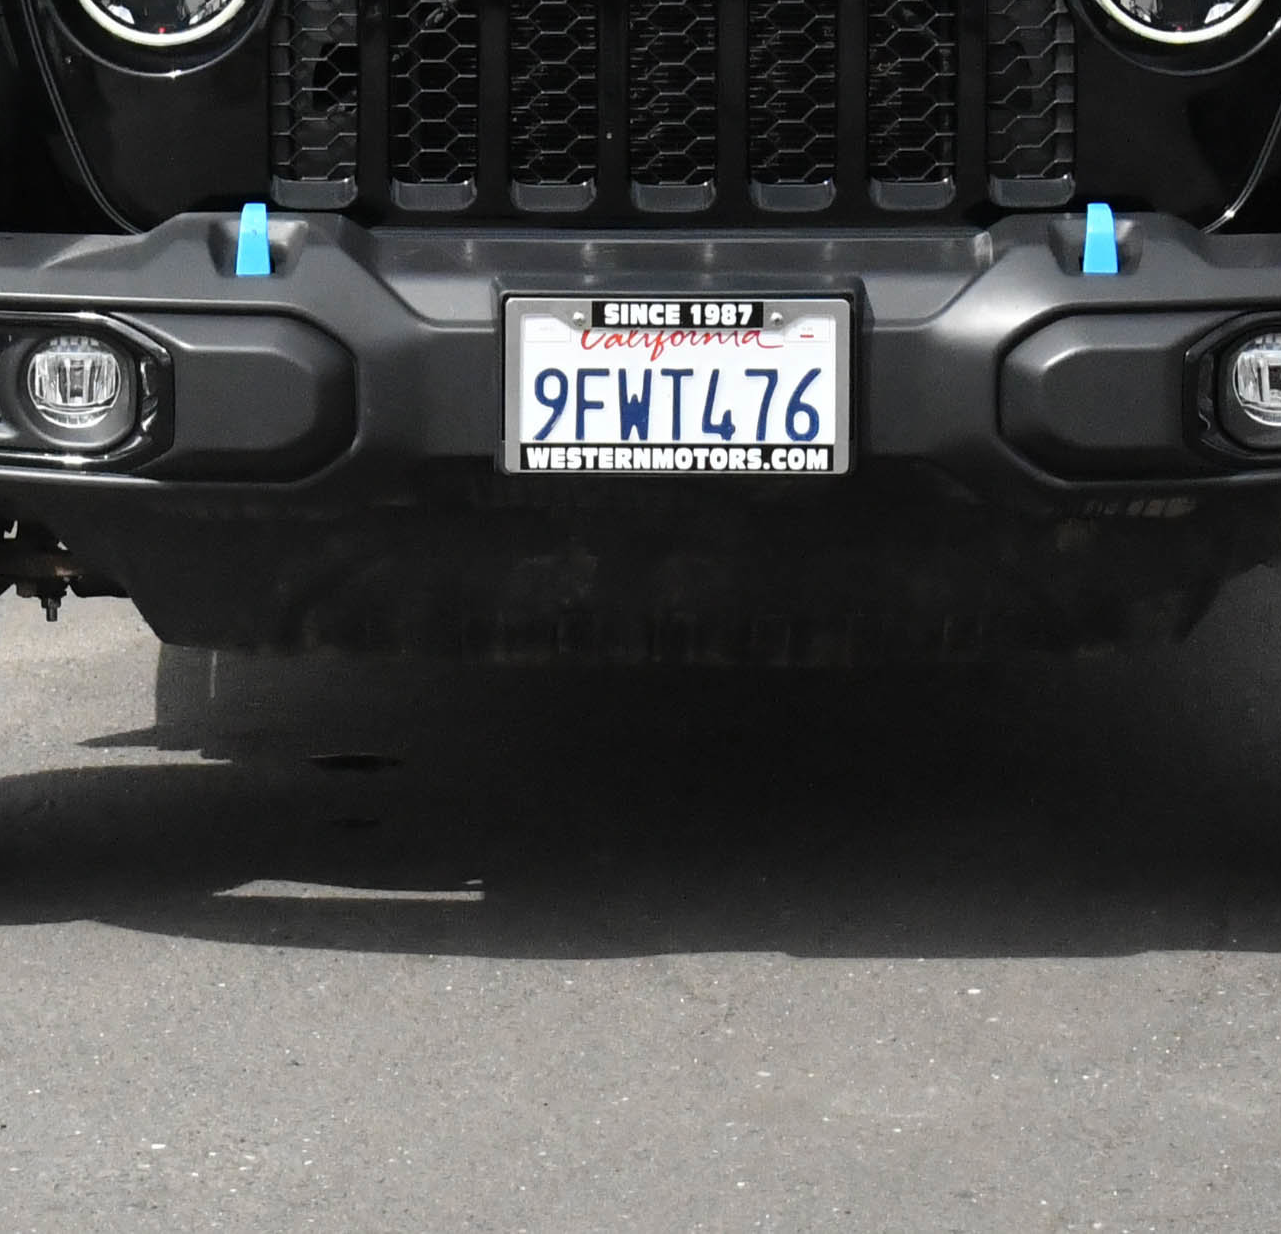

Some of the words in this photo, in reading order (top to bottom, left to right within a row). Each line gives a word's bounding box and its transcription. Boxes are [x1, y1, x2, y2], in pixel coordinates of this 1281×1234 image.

[604, 303, 681, 326] SINCE
[690, 303, 753, 326] 1987
[534, 368, 822, 442] 9FWT476
[526, 447, 829, 471] WESTERNMOTORS.COM
